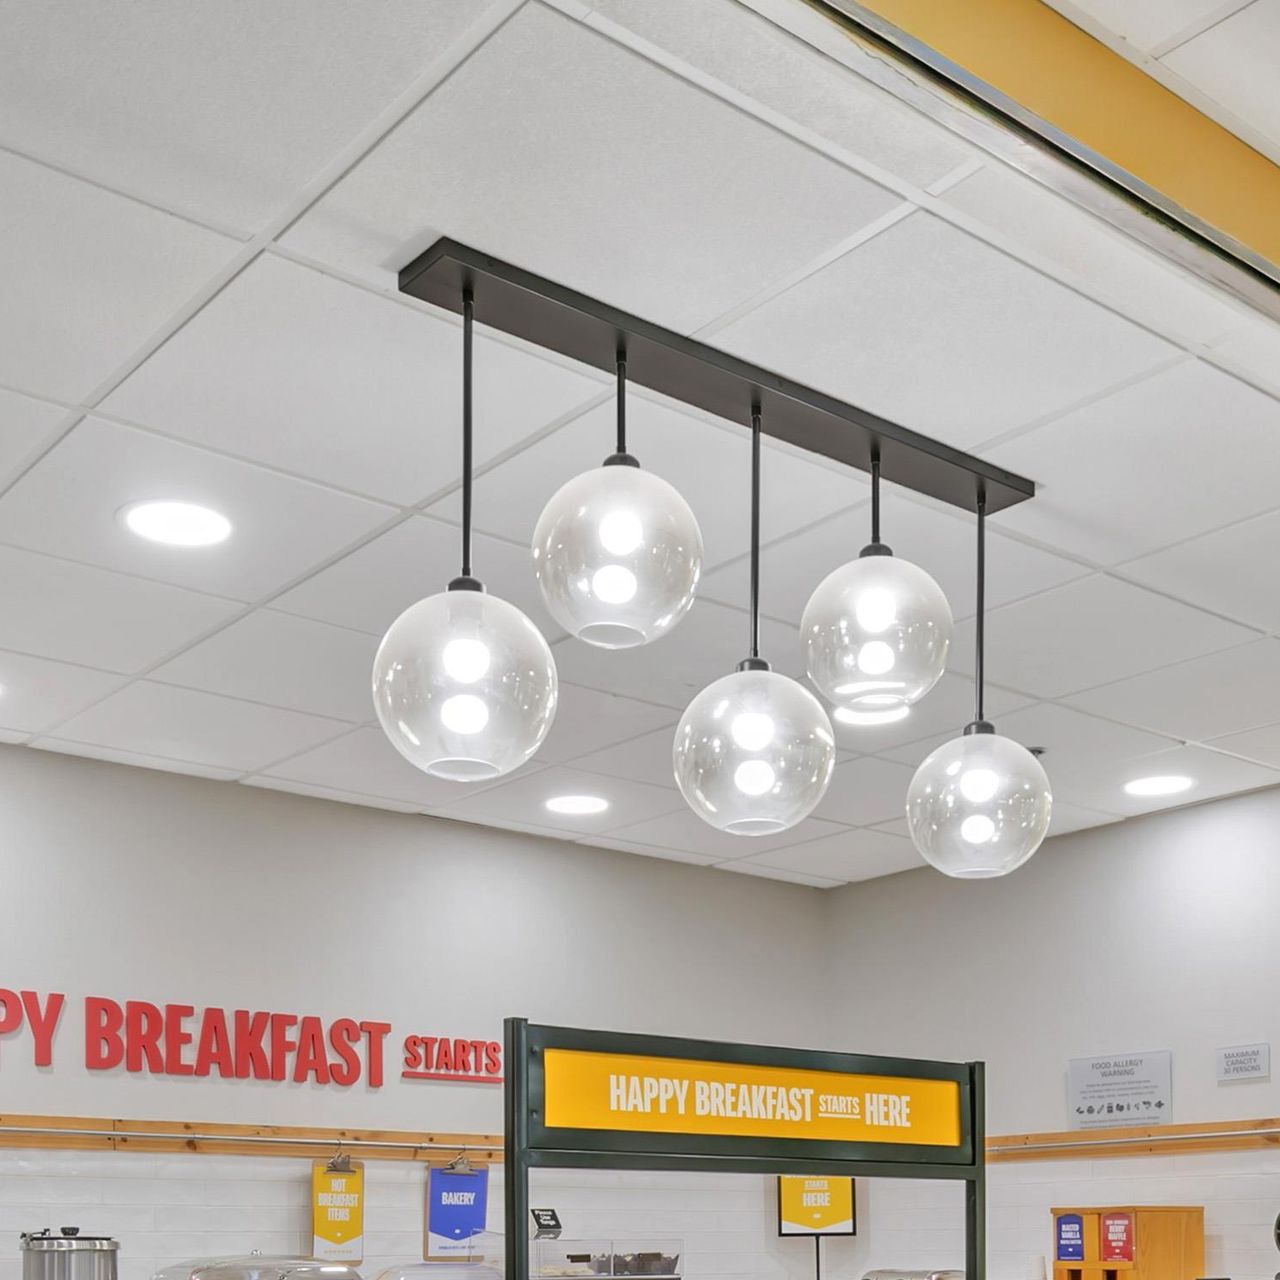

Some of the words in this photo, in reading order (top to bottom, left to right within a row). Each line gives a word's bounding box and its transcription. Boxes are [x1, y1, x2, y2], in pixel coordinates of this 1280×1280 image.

[84, 996, 392, 1088] BREAKFAST
[403, 1034, 503, 1075] STARTS
[1091, 1061, 1112, 1070] FOOD
[1113, 1059, 1144, 1068] ALLERGY
[1100, 1068, 1136, 1078] WARNING
[609, 1074, 689, 1115] HAPPY
[695, 1080, 814, 1122] BREAKFAST
[818, 1095, 860, 1114] STARTS
[864, 1092, 912, 1128] HERE
[331, 1179, 346, 1192] HOT
[318, 1193, 359, 1207] BREAKFAST
[441, 1191, 476, 1205] BAKERY
[803, 1192, 831, 1207] HERE
[328, 1208, 350, 1221] ITEMS
